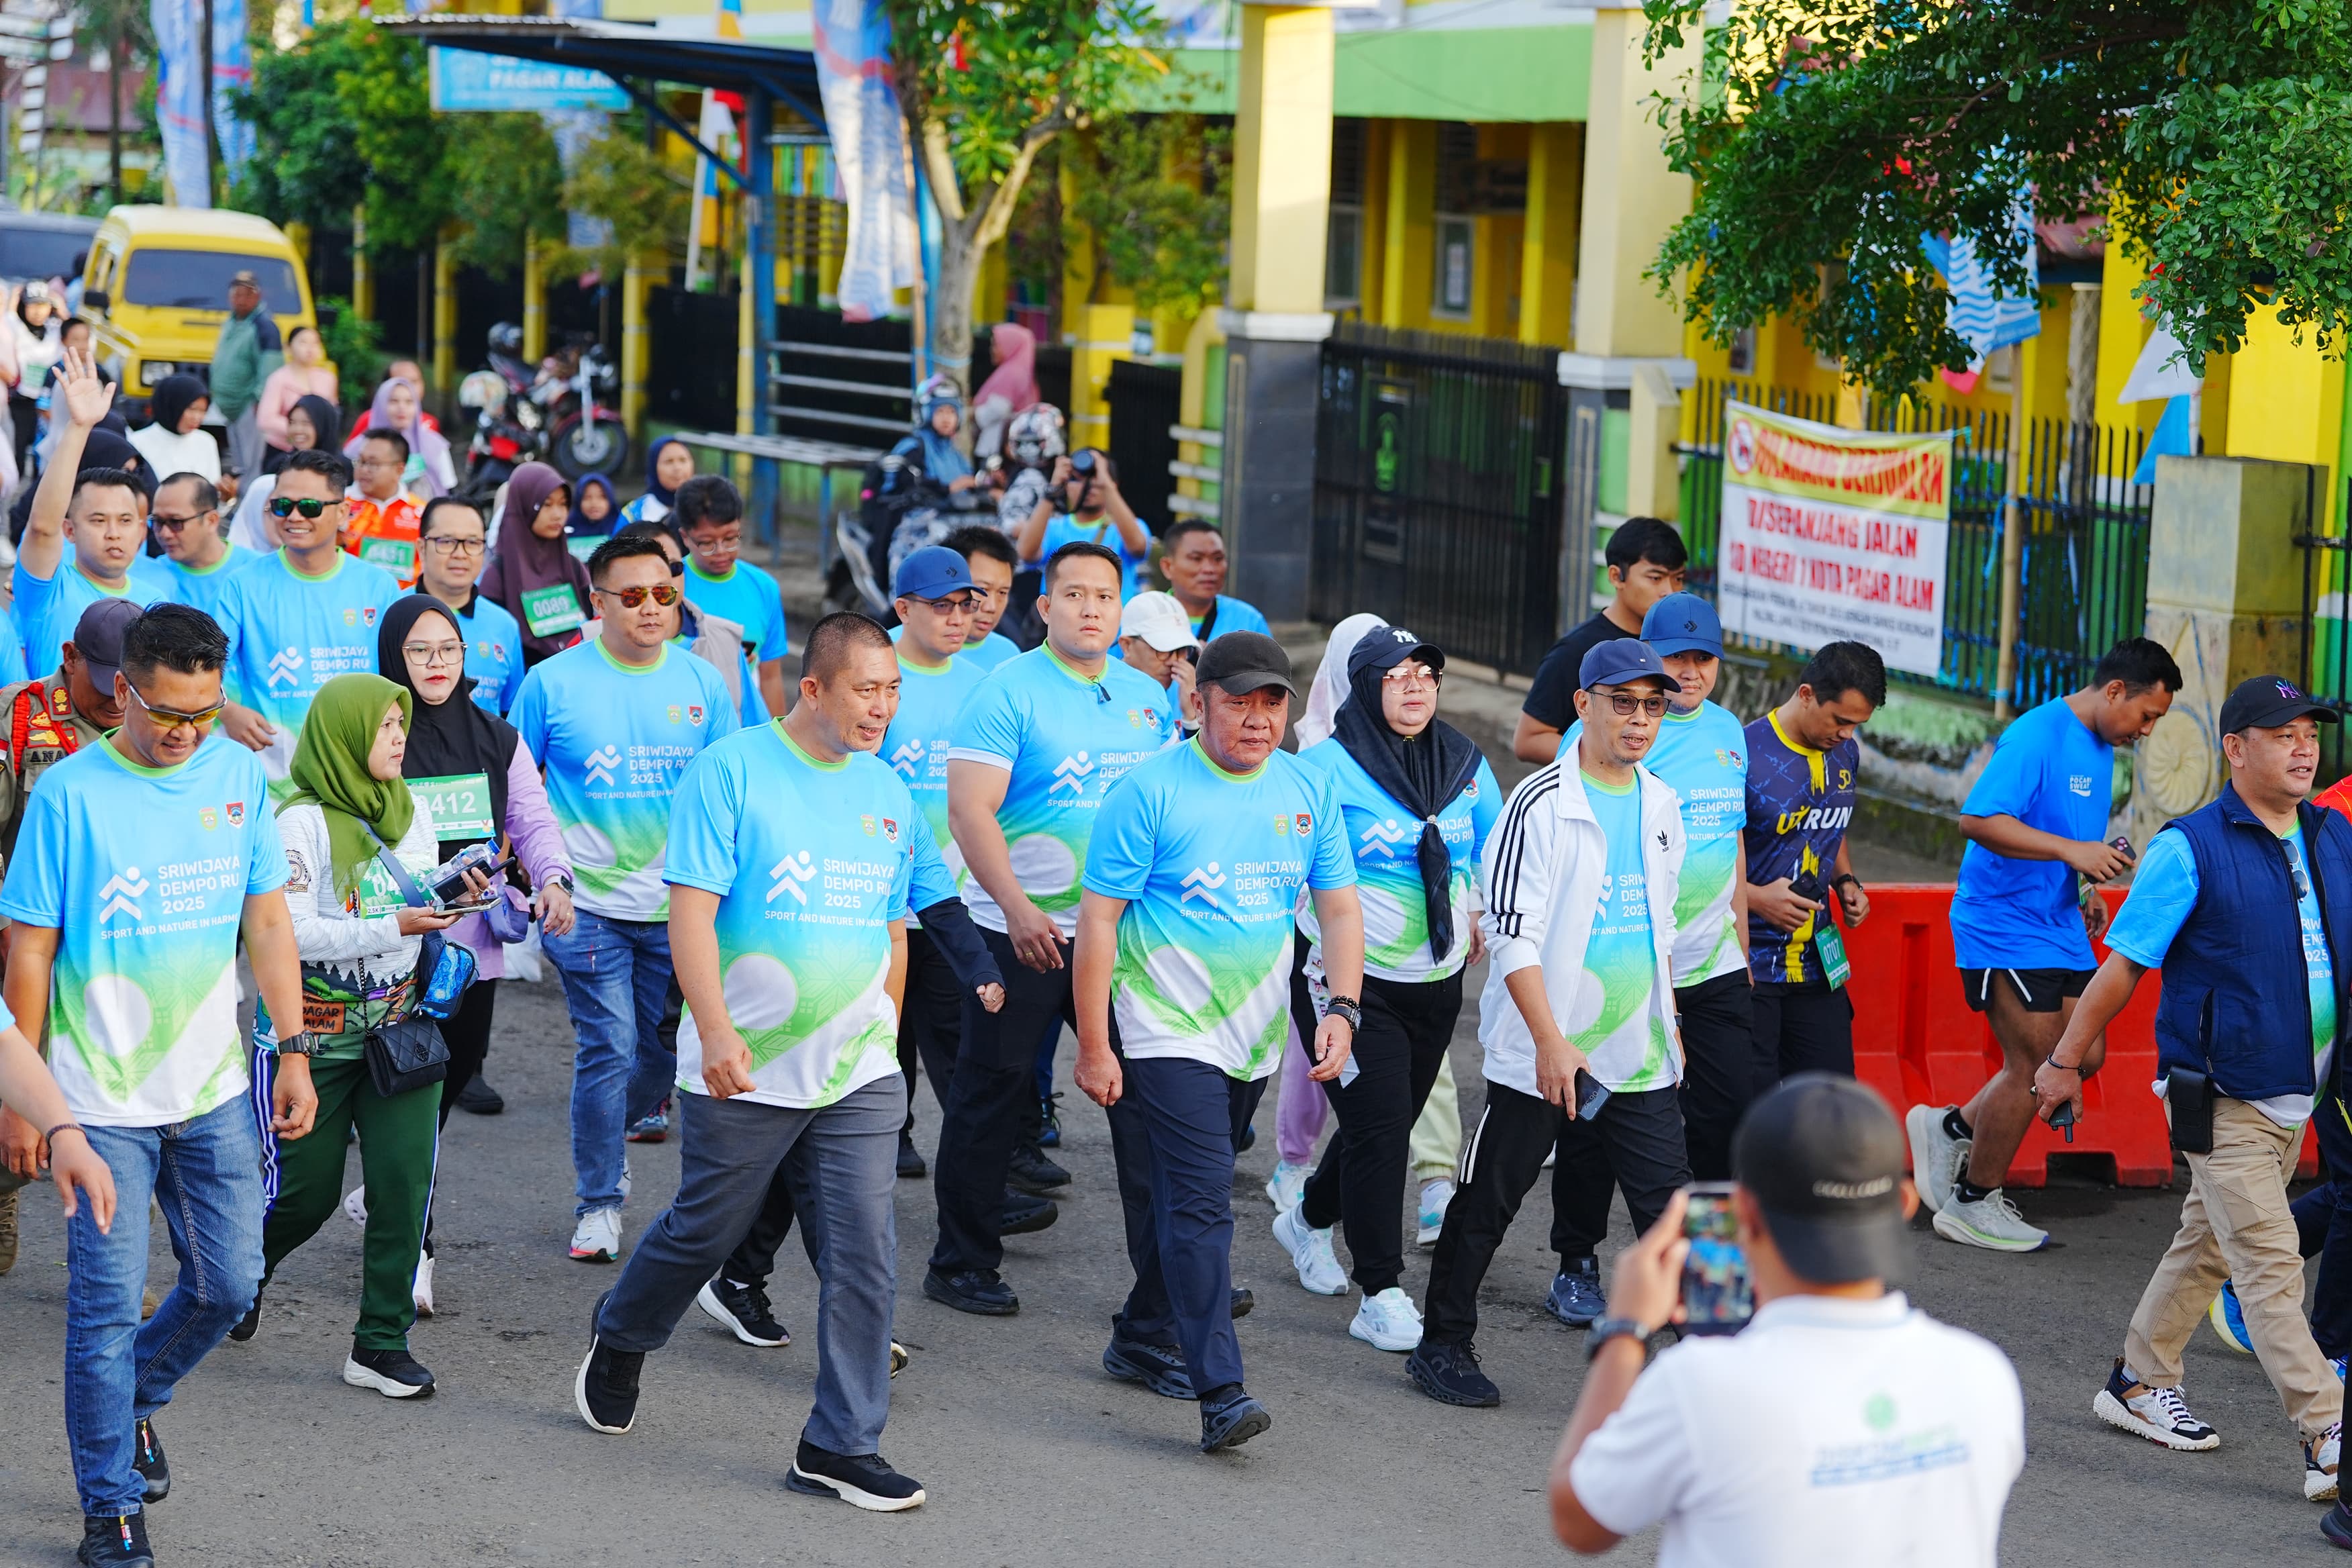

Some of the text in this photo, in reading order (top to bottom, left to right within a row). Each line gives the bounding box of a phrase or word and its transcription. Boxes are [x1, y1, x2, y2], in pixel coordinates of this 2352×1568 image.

[311, 658, 370, 671] DEMPO RU
[312, 673, 341, 684] 202
[628, 746, 694, 757] SRIWIJAYA
[629, 759, 673, 771] DEMPO
[928, 766, 948, 777] 202
[630, 773, 663, 785] 2025
[608, 791, 625, 799] AND
[626, 790, 656, 799] NATURE
[1689, 788, 1744, 799] SRIWIJAYA
[1047, 799, 1074, 807] SPORT
[1075, 800, 1094, 808] AND
[1689, 801, 1730, 813] DEMPO
[1692, 816, 1721, 826] 2025
[1689, 832, 1716, 840] NATURE
[158, 854, 241, 879] SRIWIJAYA
[823, 858, 895, 881] SRIWIJAYA
[1234, 861, 1302, 875] SRIWIJAYA
[159, 873, 239, 897] DEMPO RU
[824, 875, 873, 893] DEMPO
[1235, 877, 1280, 891] DEMPO
[824, 893, 861, 909] 2025
[1236, 893, 1269, 907] 2025
[1621, 889, 1647, 901] DEM
[162, 896, 205, 914] 2025
[1622, 903, 1647, 917] 2025
[765, 910, 796, 922] SPORT
[798, 913, 818, 923] AND
[820, 915, 854, 926] NATURE
[855, 918, 865, 926] IN
[1179, 909, 1210, 920] SPORT
[1211, 913, 1230, 922] AND
[1232, 913, 1264, 923] NATURE
[101, 928, 134, 940] SPORT
[135, 926, 156, 936] AND
[158, 920, 198, 934] NATURE
[200, 918, 210, 927] IN
[1601, 927, 1618, 935] AND
[1619, 924, 1643, 934] NATURE
[1823, 938, 1841, 965] 0707
[2304, 949, 2329, 961] 025
[303, 1018, 336, 1031] ALAM
